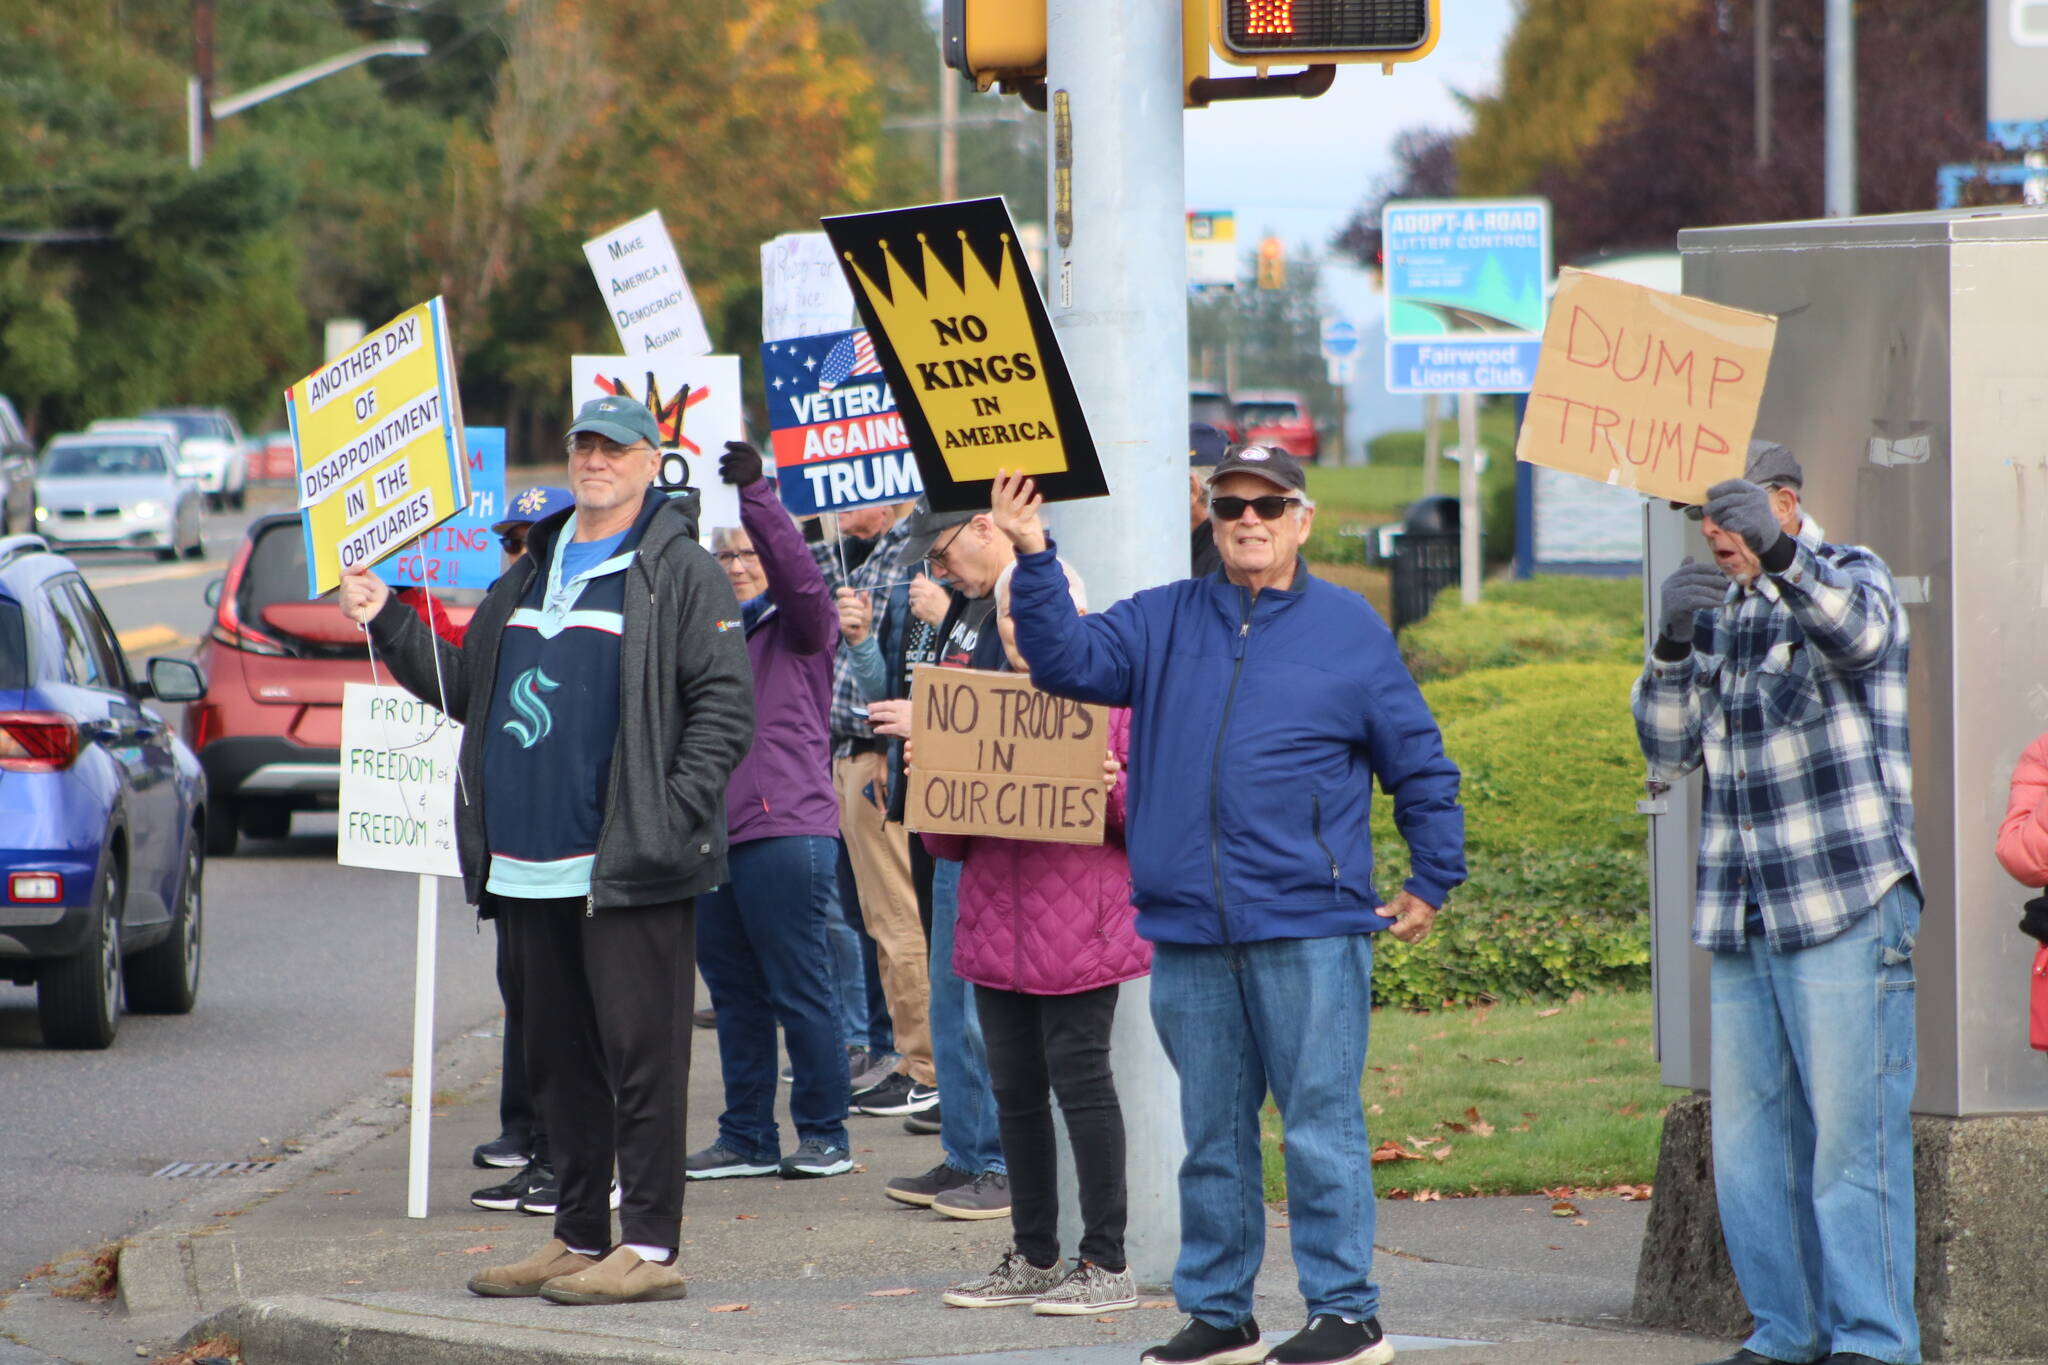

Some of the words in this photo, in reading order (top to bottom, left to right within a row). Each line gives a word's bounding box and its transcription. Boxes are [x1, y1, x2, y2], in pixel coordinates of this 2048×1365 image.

[1391, 211, 1538, 233] ADOPT-A-ROAD
[1392, 236, 1452, 250] LITTER
[1456, 233, 1538, 249] CONTROL
[930, 314, 988, 346] NO
[311, 341, 383, 406] ANOTHER
[384, 318, 415, 356] DAY
[915, 352, 1037, 391] KINGS
[1418, 345, 1518, 365] Fairwood
[1566, 304, 1745, 409] DUMP
[1410, 367, 1470, 387] Lions
[1474, 366, 1525, 386] Club
[355, 390, 375, 420] OF
[789, 382, 896, 425] VETERA
[971, 396, 1001, 417] IN
[304, 395, 440, 498] DISAPPOINTMENT
[802, 415, 911, 461] AGAINS
[944, 420, 1056, 449] AMERICA
[1535, 393, 1730, 483] TRUMP
[346, 489, 365, 518] IN
[376, 463, 409, 500] THE
[803, 451, 924, 508] TRUM
[341, 494, 430, 568] OBITUARIES
[396, 555, 441, 583] FOR
[370, 696, 458, 729] PROTE
[927, 683, 979, 734] NO
[990, 688, 1094, 740] TROOPS
[350, 748, 433, 785] FREEDOM
[977, 739, 1016, 773] IN
[924, 776, 989, 824] OUR
[995, 781, 1099, 829] CITIES
[348, 811, 427, 848] FREEDOM
